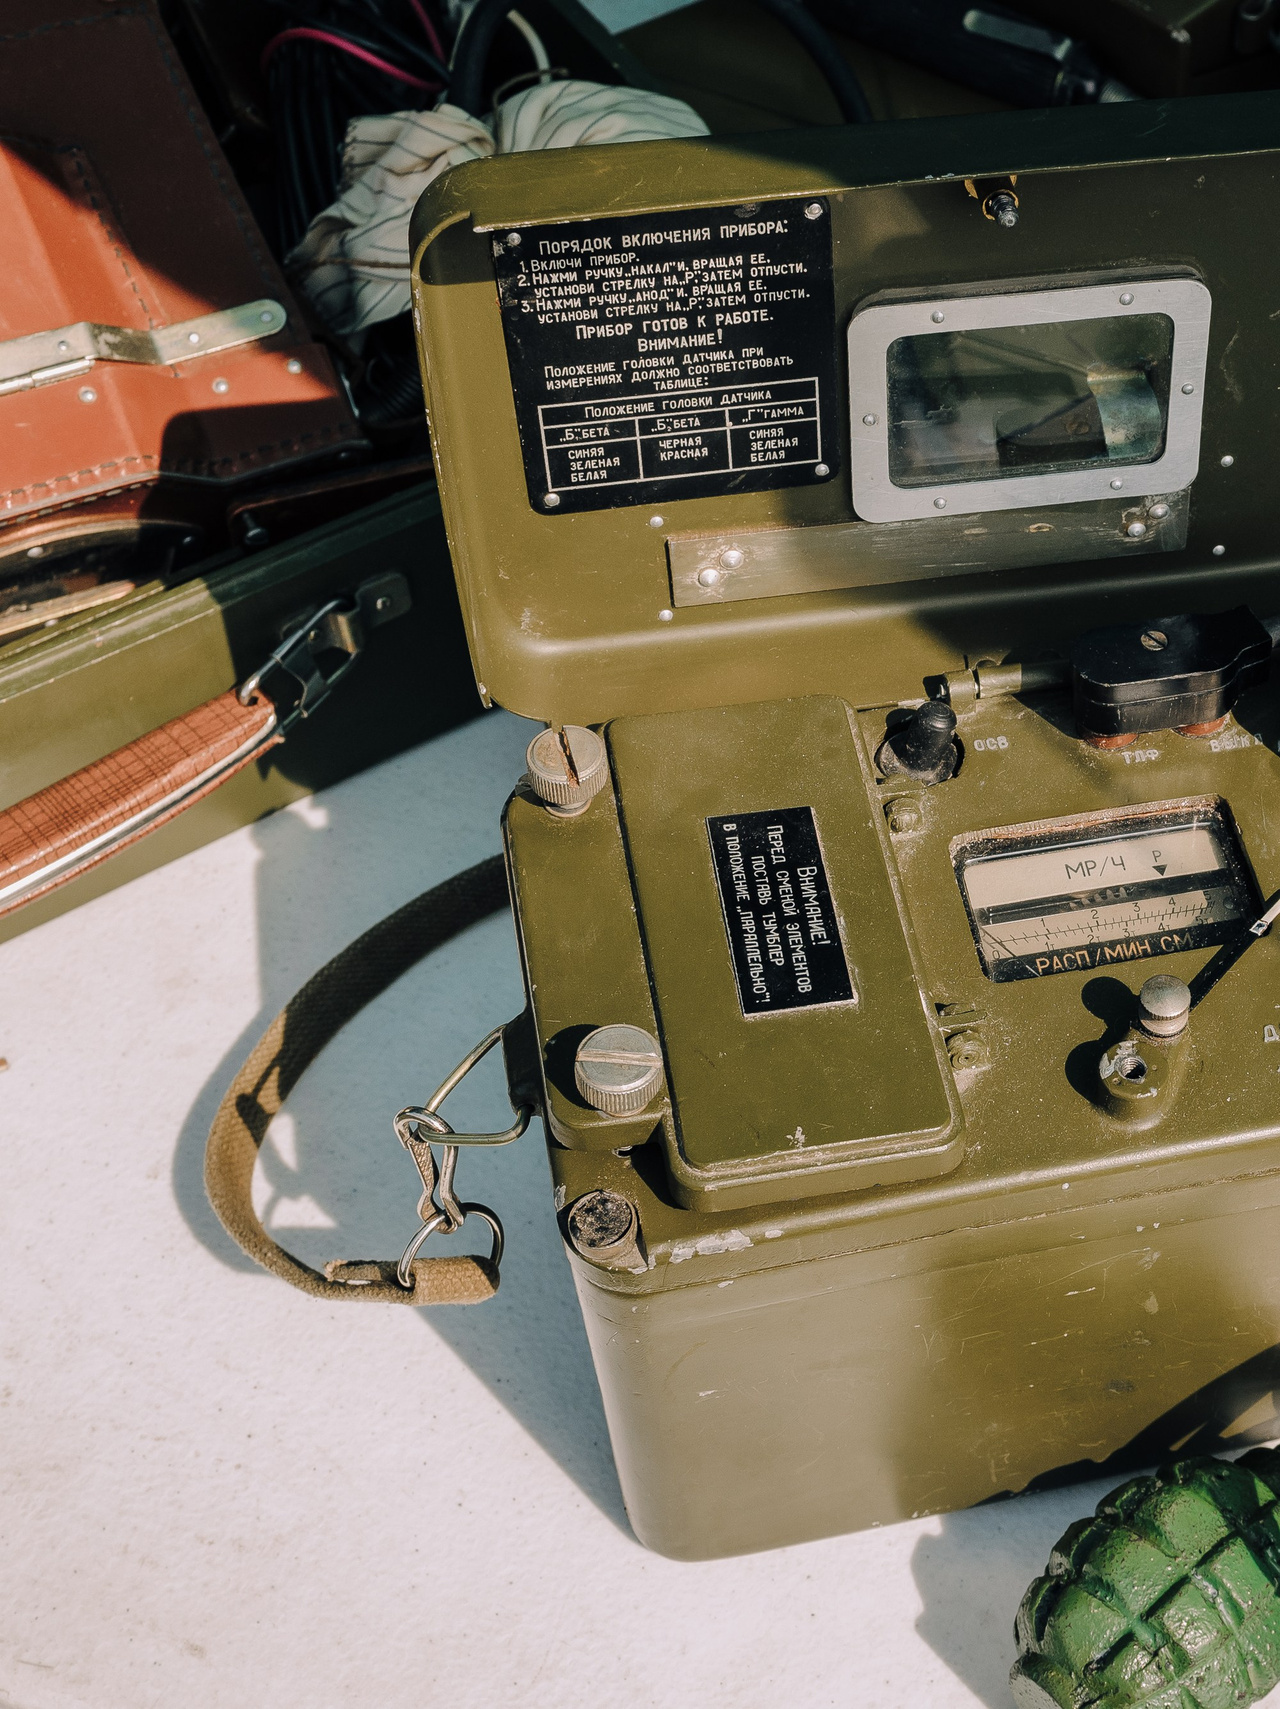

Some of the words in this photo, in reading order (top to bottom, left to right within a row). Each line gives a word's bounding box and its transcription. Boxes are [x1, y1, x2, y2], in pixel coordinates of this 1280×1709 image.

[539, 237, 612, 255] ПОРЯДОК
[622, 227, 711, 248] ВКЛЮЧЕНИЯ
[720, 219, 788, 239] ПРИБОРА:
[531, 257, 582, 272] ВКЛЮЧИ
[590, 252, 640, 266] ПРИБОР.
[532, 271, 578, 285] НАЖМИ
[692, 255, 743, 270] ВРАЩАЯ
[533, 283, 595, 299] УСТАНОВИ
[602, 277, 656, 292] СТРЕЛКУ
[702, 268, 743, 282] ЗАТЕМ
[750, 262, 808, 277] ОТПУСТИ.
[535, 297, 582, 312] НАЖМИ
[692, 281, 742, 297] ВРАЩАЯ
[537, 309, 598, 324] УСТАНОВИ
[605, 303, 658, 318] СТРЕЛКУ
[706, 294, 746, 308] ЗАТЕМ
[754, 288, 810, 303] ОТПУСТИ.
[575, 322, 633, 340] ПРИБОР
[642, 317, 688, 333] ГОТОВ
[697, 315, 707, 328] К
[715, 309, 774, 326] РАБОТЕ.
[637, 328, 723, 352] ВНИМАНИЕ!
[544, 362, 616, 378] ПОЛОЖЕНИЕ
[622, 356, 675, 371] ГОЛОВКИ
[682, 349, 735, 365] ДАТЧИКА
[742, 347, 764, 358] ПРИ
[546, 373, 623, 391] ИЗМЕРЕНИЯХ
[631, 367, 680, 383] ДОЛЖНО
[687, 356, 794, 376] СООТВЕТСТВОВАТЬ
[653, 376, 709, 391] ТАБЛИЦЕ:
[584, 402, 655, 419] ПОЛОЖЕНИЕ
[662, 396, 713, 410] ГОЛОВКИ
[720, 390, 772, 406] ДАТЧИКА
[659, 436, 702, 449] ЧЕРНАЯ
[749, 427, 784, 440] СИНЯЯ
[750, 437, 798, 451] ЗЕЛЕНАЯ
[568, 447, 605, 460] СИНЯЯ
[570, 456, 620, 471] ЗЕЛЕНАЯ
[660, 447, 708, 461] КРАСНАЯ
[750, 450, 785, 463] БЕЛАЯ
[570, 469, 607, 483] БЕЛАЯ
[723, 823, 737, 832] В
[767, 825, 786, 865] ПЕРЕД
[725, 836, 750, 902] ПОЛОЖЕНИЕ
[1064, 855, 1127, 880] МР/Ч
[776, 870, 797, 916] СМЕНОЙ
[797, 866, 831, 945] ВНИМАНИЕ!
[751, 855, 772, 905] ПОСТАВЬ
[762, 911, 785, 966] ТУМБЛЕР
[786, 922, 812, 993] ЭЛЕМЕНТОВ
[1035, 939, 1152, 977] РАСП/МИН
